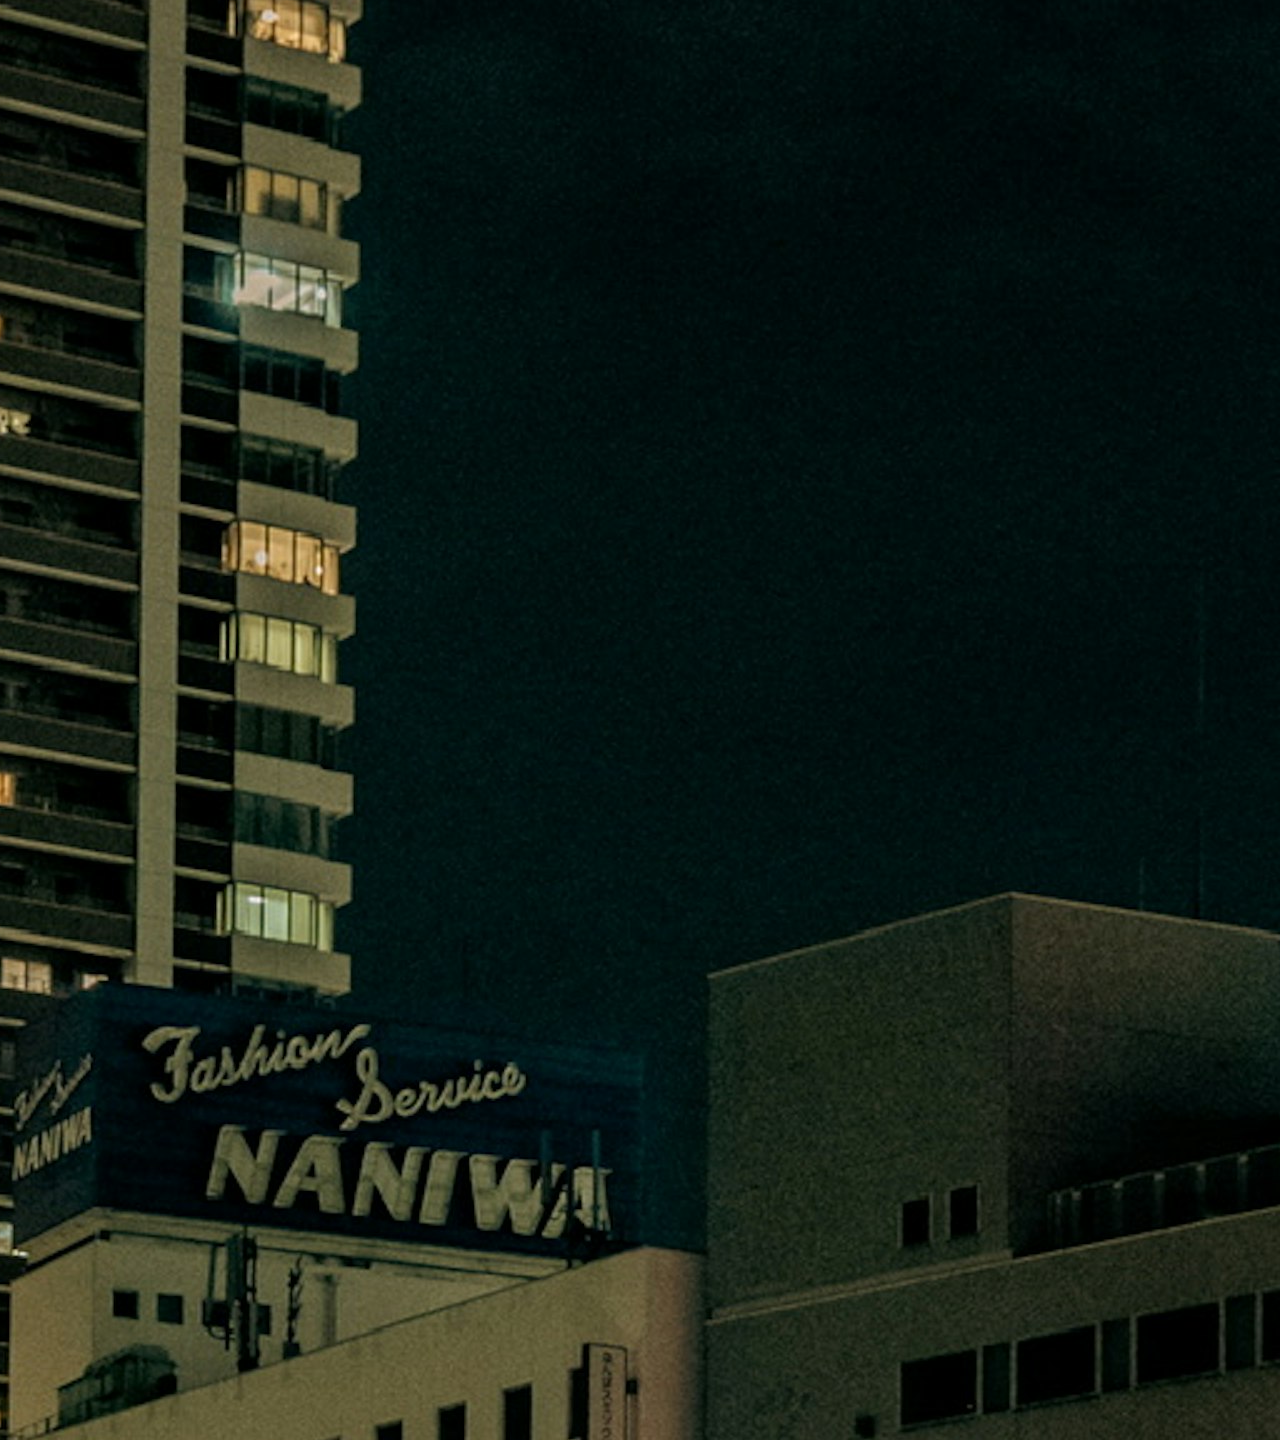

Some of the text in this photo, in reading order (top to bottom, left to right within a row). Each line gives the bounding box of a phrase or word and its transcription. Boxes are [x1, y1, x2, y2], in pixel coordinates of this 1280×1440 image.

[141, 1024, 371, 1103] Fashion
[334, 1047, 526, 1131] Service
[12, 1106, 93, 1181] NANIWA
[206, 1124, 613, 1240] NANIWA
